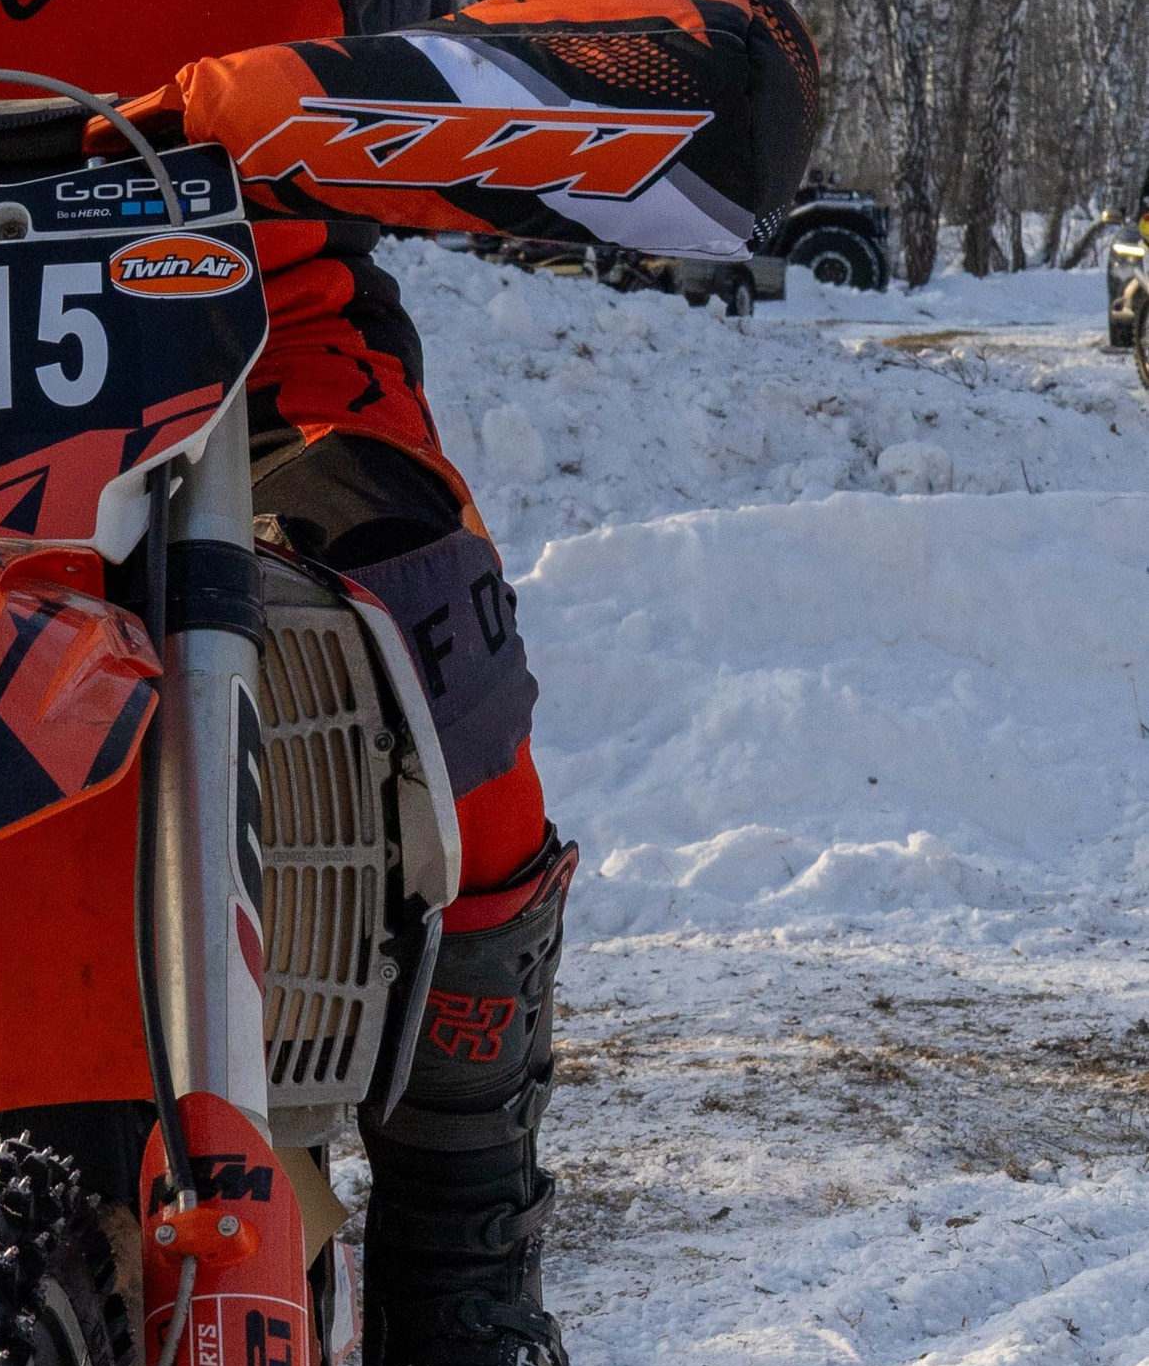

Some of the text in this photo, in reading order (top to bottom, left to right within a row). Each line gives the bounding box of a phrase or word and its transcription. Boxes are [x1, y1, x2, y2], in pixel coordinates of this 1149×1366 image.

[236, 96, 716, 202] KTM
[56, 178, 211, 202] GoPo
[57, 210, 69, 219] Be
[120, 255, 240, 281] Twin Air
